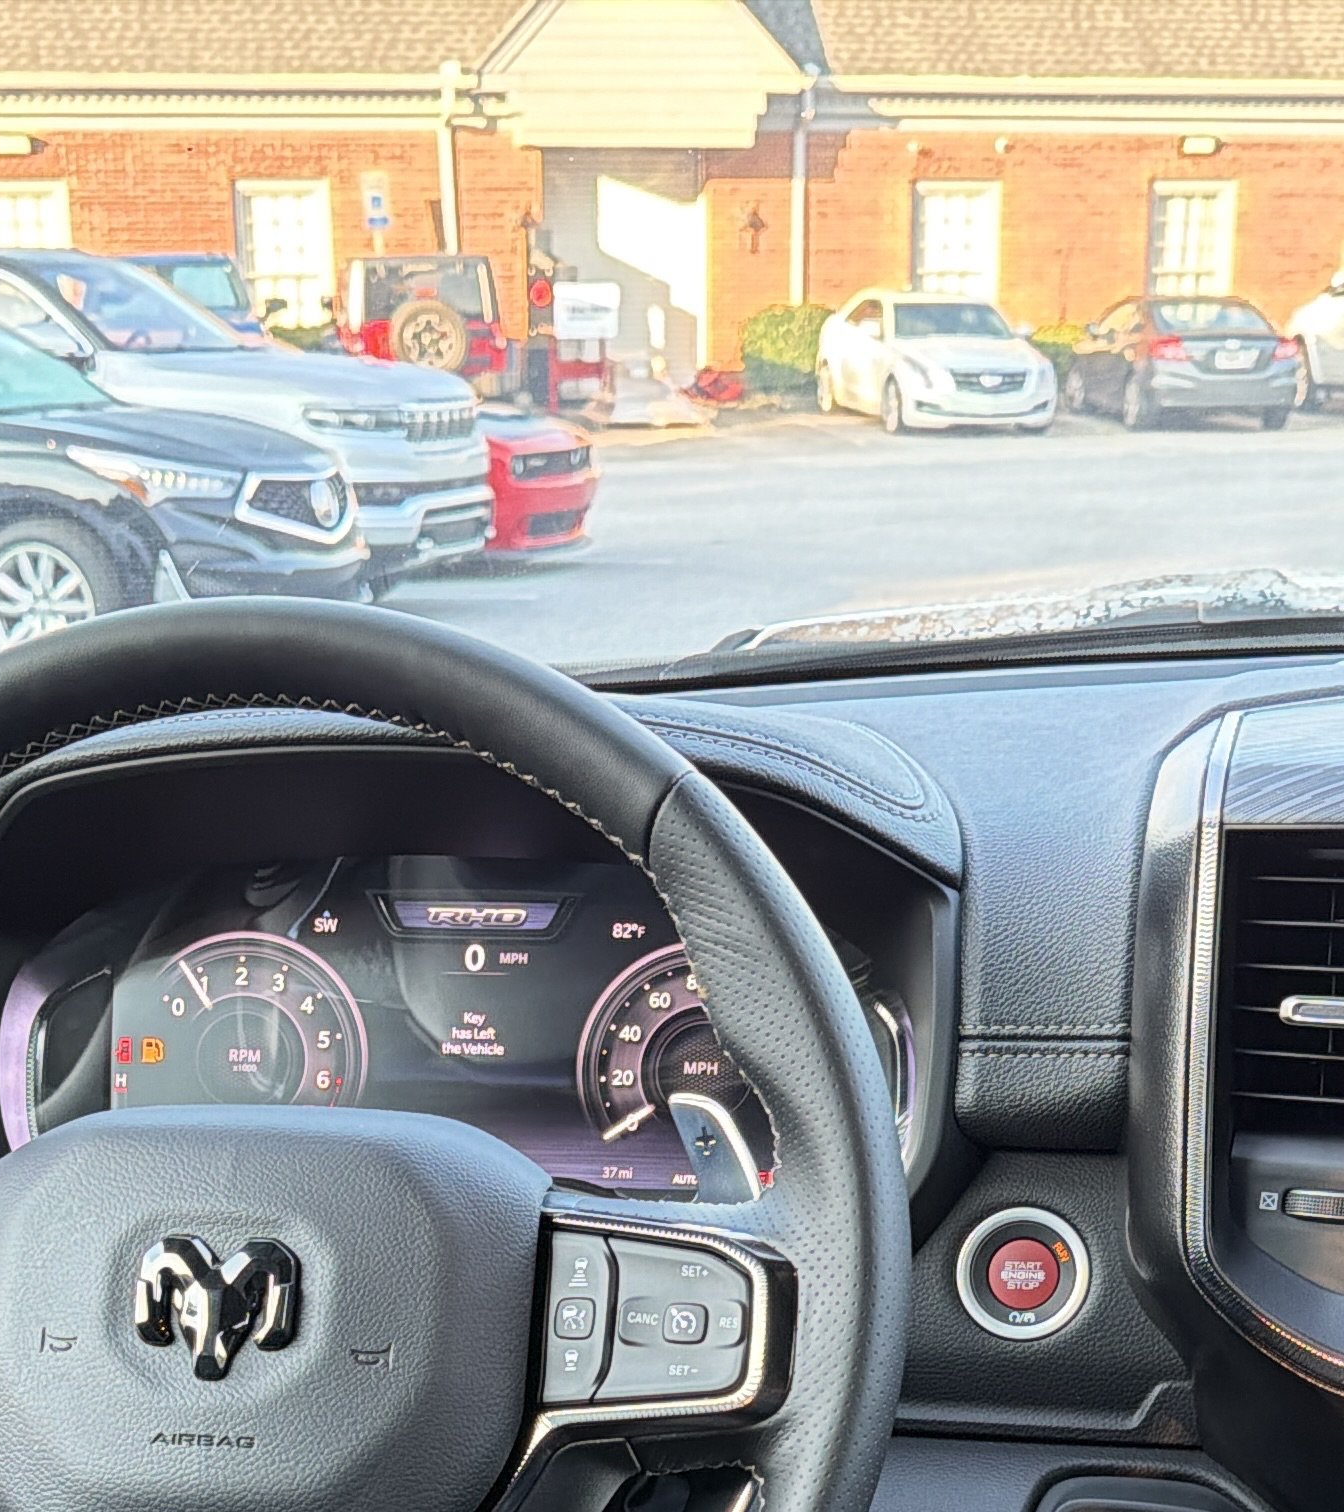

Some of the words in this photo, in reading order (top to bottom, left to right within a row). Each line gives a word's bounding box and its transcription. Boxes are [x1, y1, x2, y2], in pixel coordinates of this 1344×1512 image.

[427, 907, 527, 926] RHO
[314, 918, 339, 933] SW
[612, 923, 646, 939] 82°F
[464, 944, 485, 972] 0
[499, 953, 528, 964] MPH
[200, 976, 209, 991] 1
[235, 967, 248, 986] 2
[272, 973, 285, 992] 3
[171, 998, 185, 1016] 0
[300, 996, 314, 1014] 4
[649, 992, 671, 1008] 60
[464, 1012, 485, 1027] Key
[317, 1030, 330, 1048] 5
[452, 1027, 473, 1040] has
[474, 1027, 496, 1040] Left
[619, 1025, 641, 1042] 40
[229, 1049, 261, 1063] RPM
[442, 1042, 461, 1055] the
[462, 1043, 504, 1056] Vehicle
[683, 1061, 718, 1075] MPH
[115, 1073, 127, 1088] H
[316, 1071, 331, 1089] 6
[611, 1069, 634, 1086] 20
[602, 1168, 617, 1179] 37
[618, 1167, 633, 1179] mi
[1004, 1261, 1043, 1270] START
[1000, 1270, 1045, 1281] ENGINE
[1006, 1281, 1040, 1290] STOP
[627, 1311, 658, 1325] CANC
[719, 1316, 738, 1328] RES
[150, 1431, 255, 1449] AIRBAG
